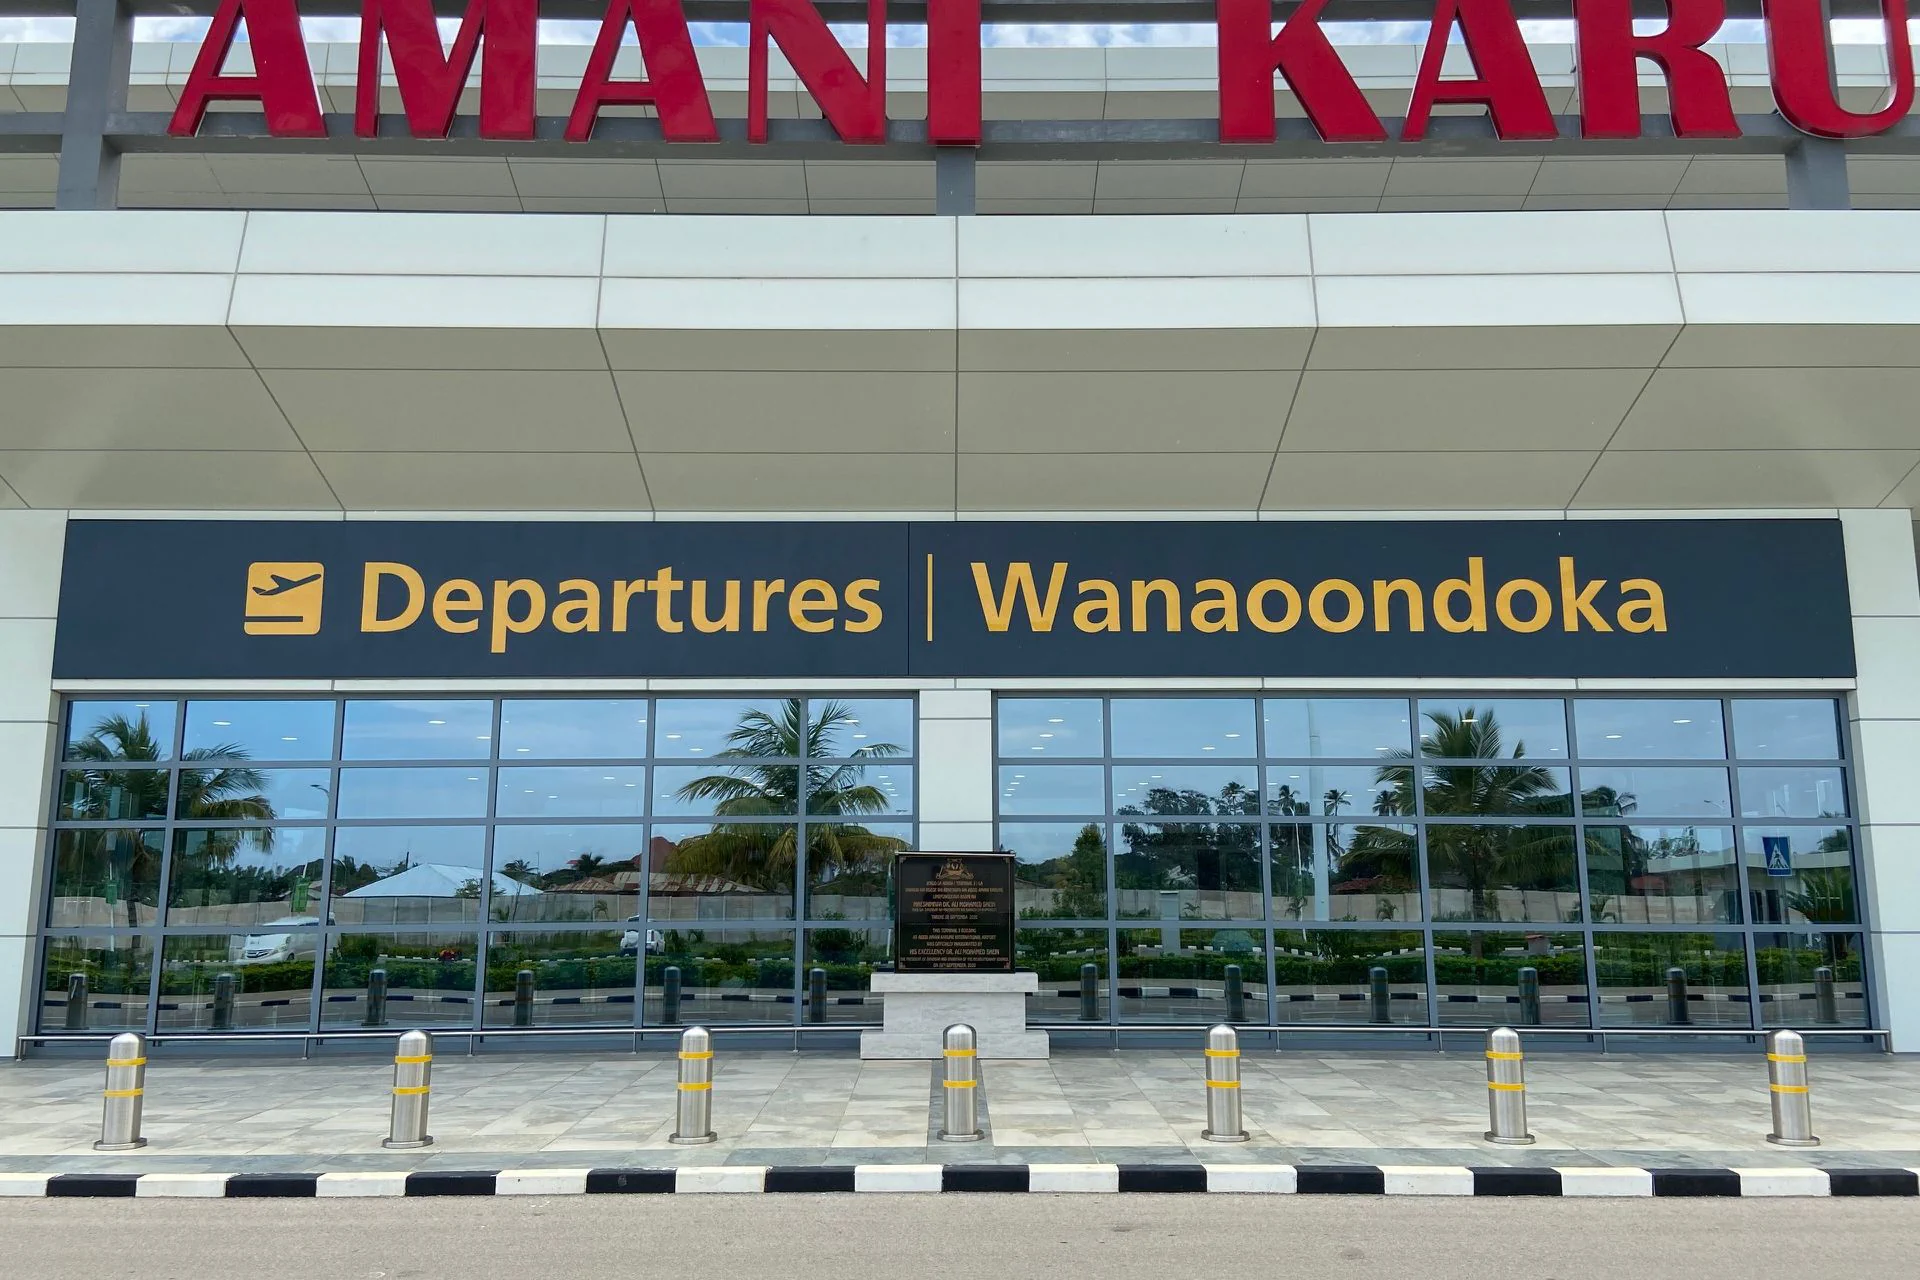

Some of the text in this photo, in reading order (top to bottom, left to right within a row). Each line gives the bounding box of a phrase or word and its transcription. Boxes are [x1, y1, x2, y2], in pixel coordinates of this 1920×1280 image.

[167, 0, 982, 145] AMANI
[360, 562, 882, 653] Departures
[970, 556, 1668, 633] Wanaoondoka
